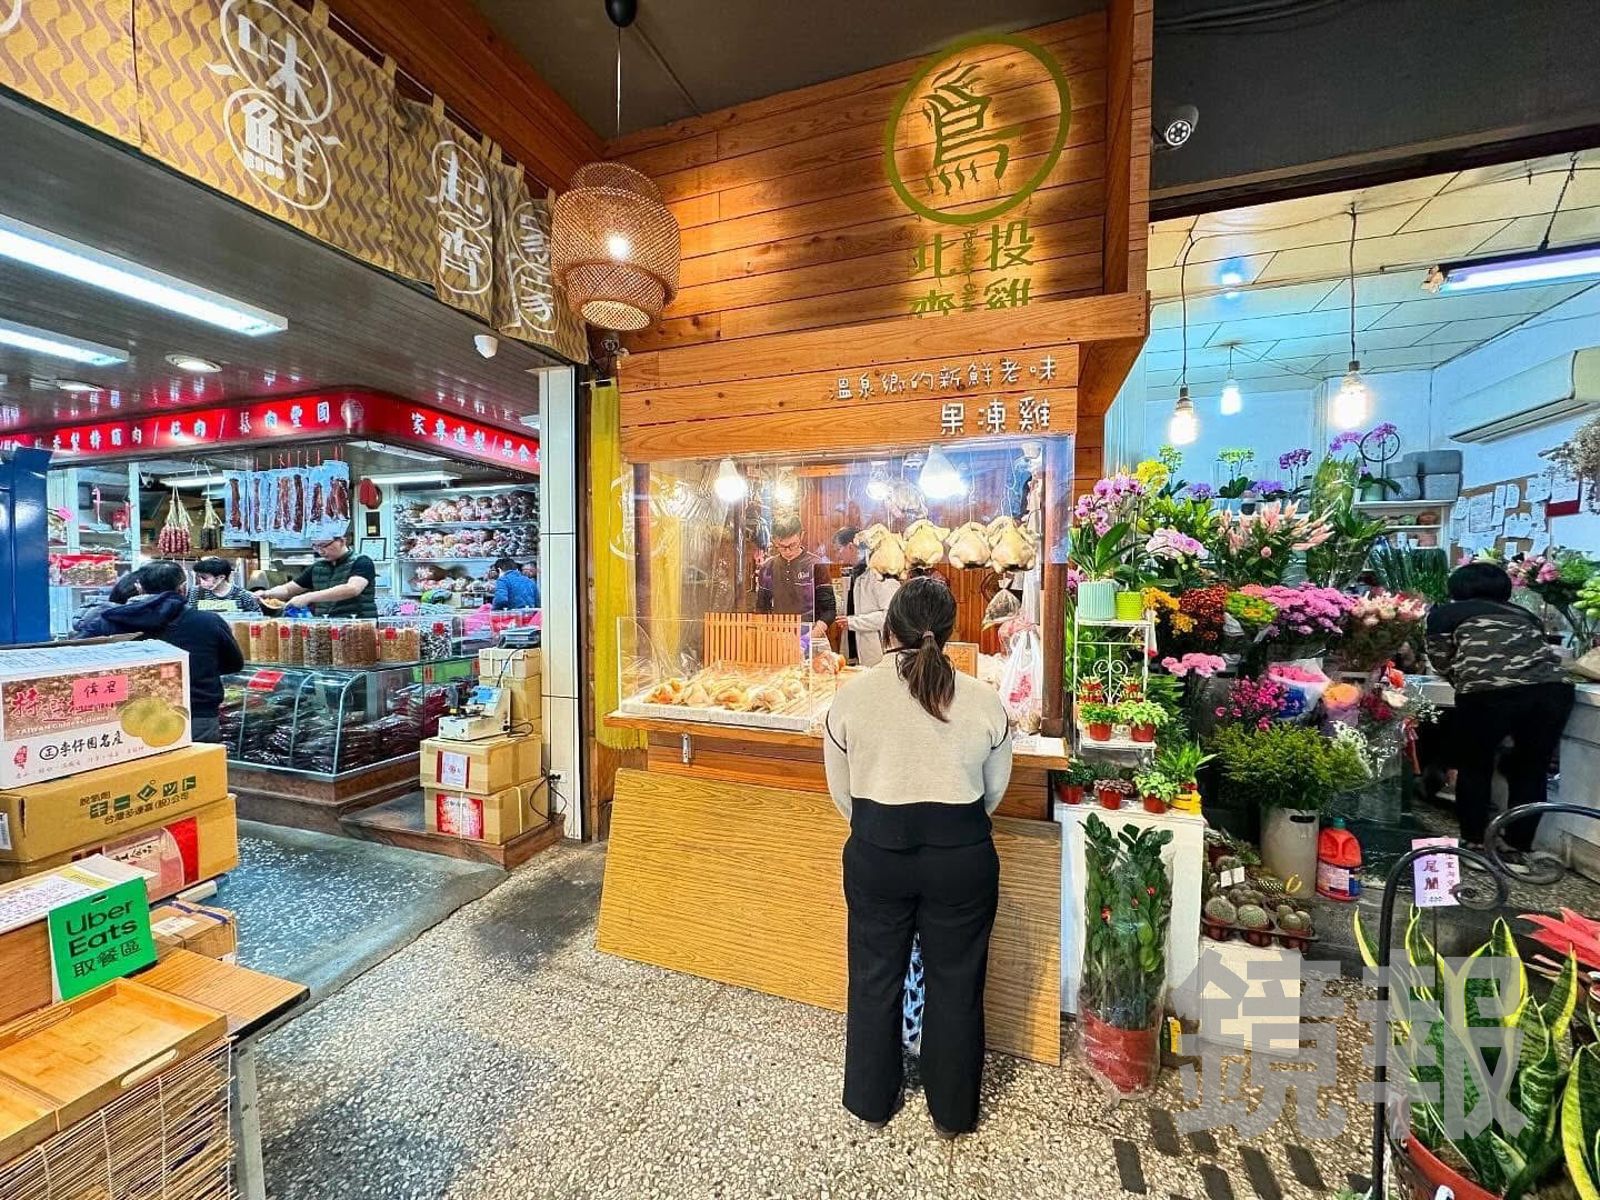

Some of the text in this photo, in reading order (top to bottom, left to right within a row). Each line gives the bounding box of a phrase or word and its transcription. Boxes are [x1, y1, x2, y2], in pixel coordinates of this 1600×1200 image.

[940, 396, 1051, 436] 果凍雞
[66, 899, 135, 935] Uber
[68, 918, 139, 958] Eats
[72, 938, 142, 978] 取餐區
